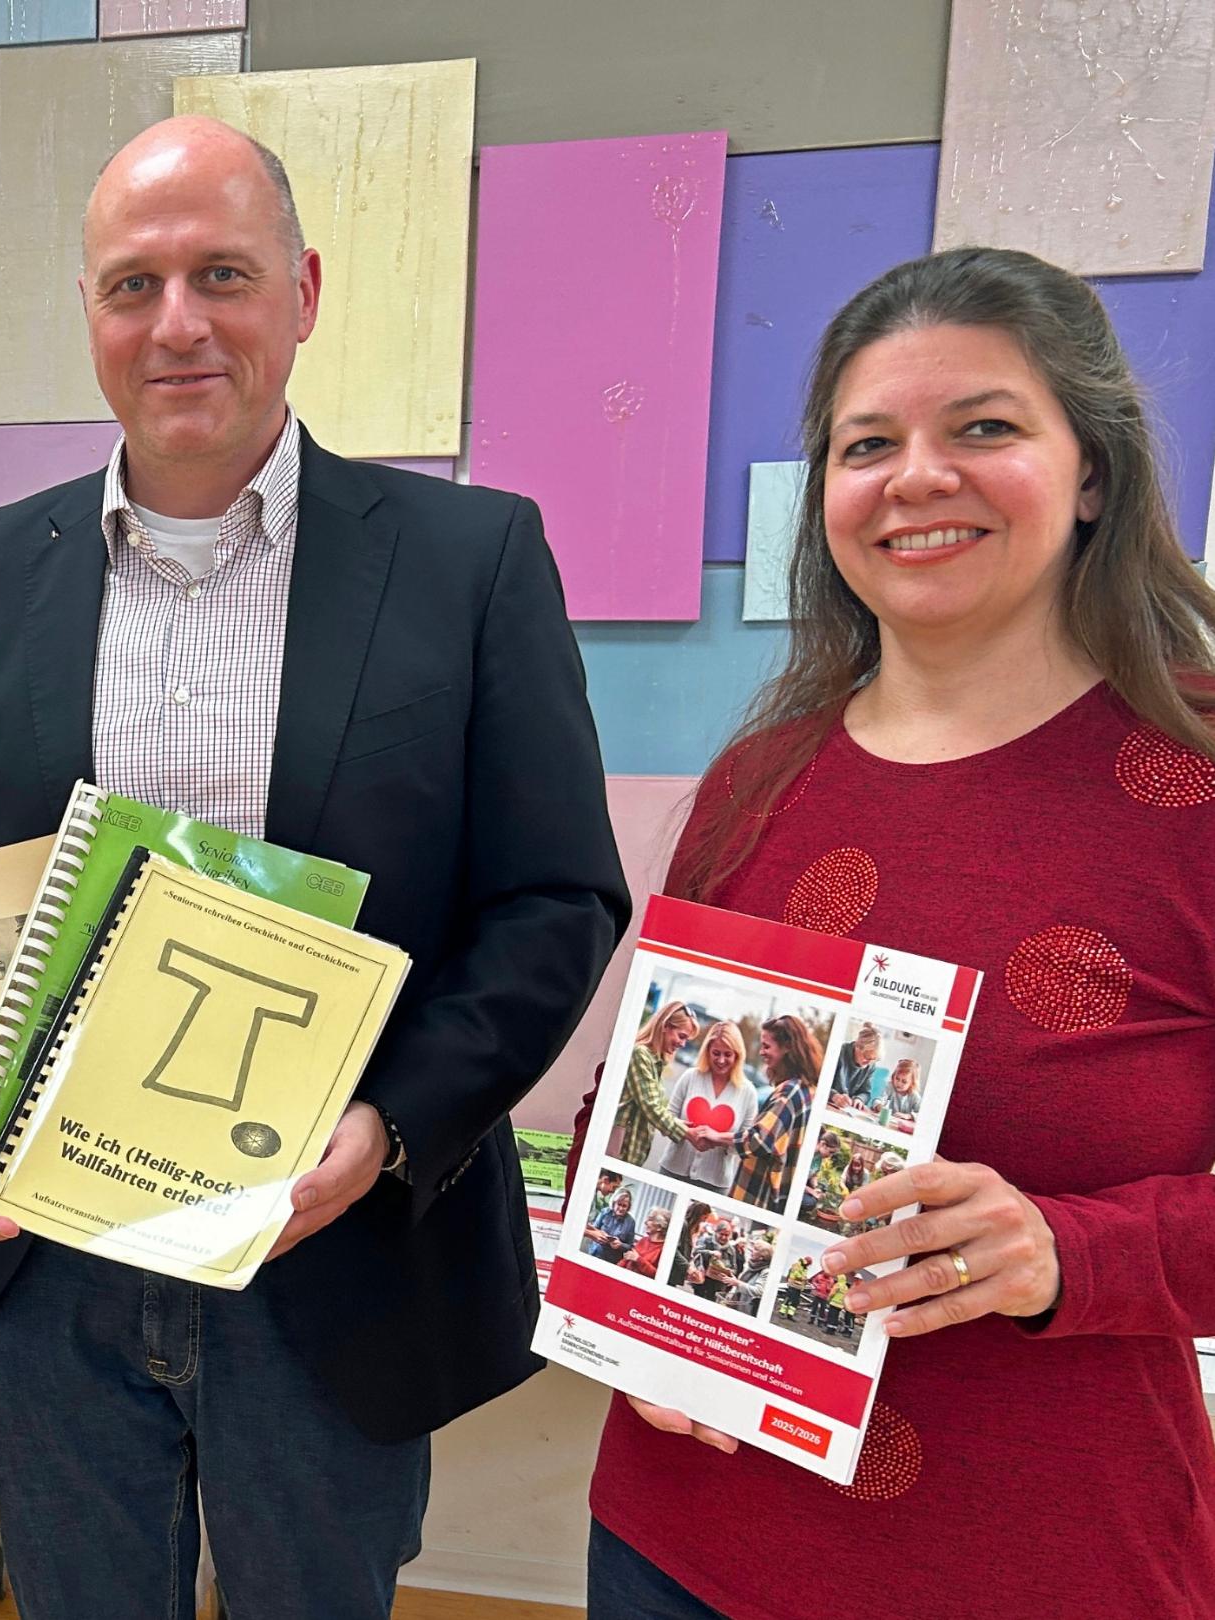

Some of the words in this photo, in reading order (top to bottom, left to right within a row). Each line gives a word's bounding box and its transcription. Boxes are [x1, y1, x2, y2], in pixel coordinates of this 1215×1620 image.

[103, 807, 143, 833] KEB
[305, 872, 345, 897] CEB
[204, 905, 242, 926] schreiben
[243, 921, 287, 945] Geschichte
[288, 940, 305, 952] und
[873, 976, 921, 997] BILDUNG
[900, 998, 936, 1016] LEBEN
[59, 1115, 91, 1142] Wie
[94, 1132, 122, 1156] ich
[60, 1142, 158, 1193] Wallfahrten
[31, 1190, 116, 1229] Aufsatzveranstaltung
[682, 1314, 717, 1334] Herzen
[605, 1311, 617, 1322] 40.
[617, 1317, 693, 1354] Aufsatzveranstaltung
[693, 1345, 705, 1357] für
[706, 1351, 752, 1376] Seniorinnen
[752, 1369, 768, 1382] und
[769, 1375, 803, 1396] Senioren
[629, 1308, 684, 1338] Geschichten
[685, 1331, 704, 1344] der
[704, 1336, 784, 1376] Hilfsbereitschaft
[770, 1417, 822, 1445] 2025/2026
